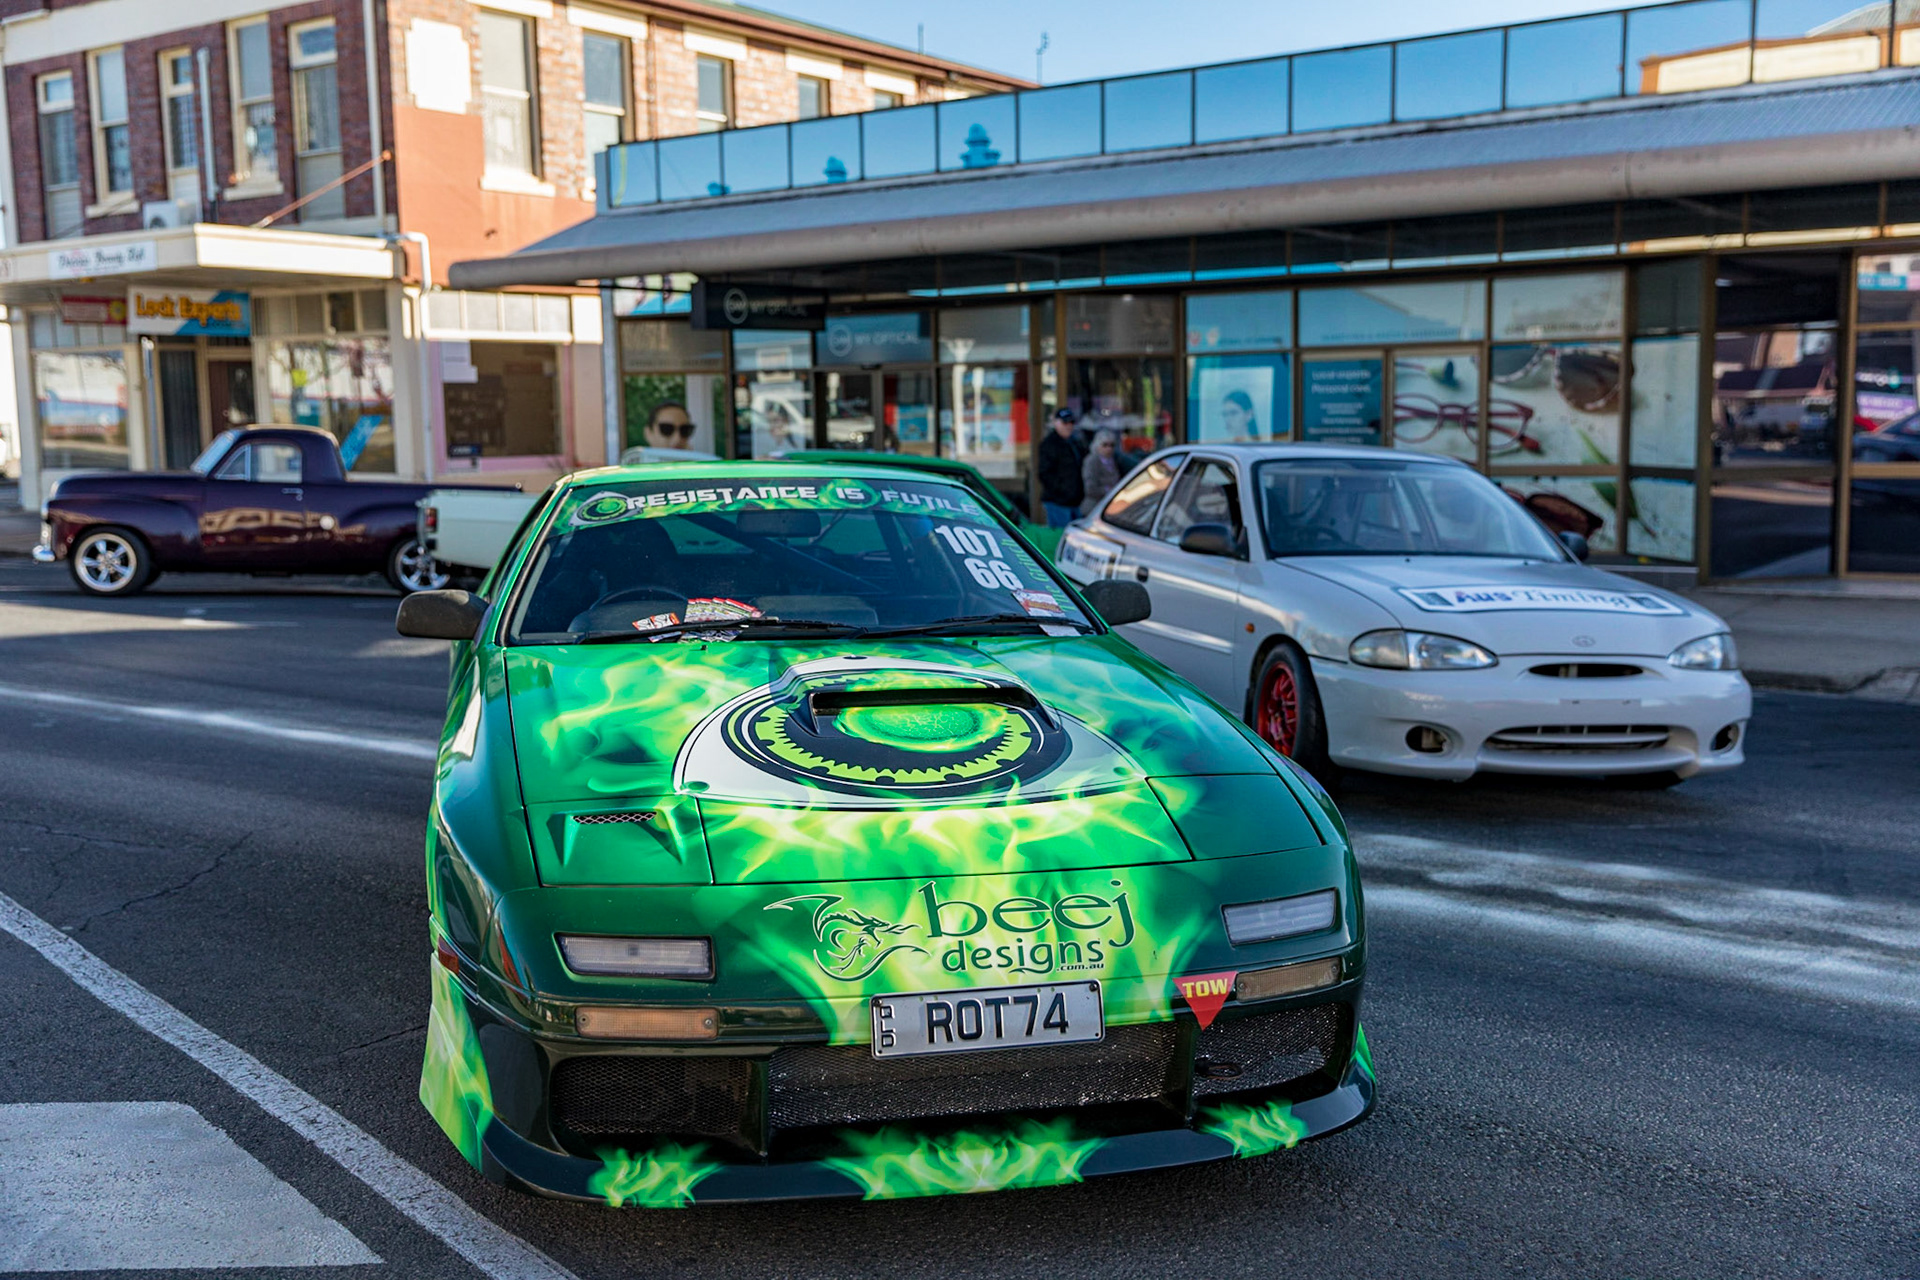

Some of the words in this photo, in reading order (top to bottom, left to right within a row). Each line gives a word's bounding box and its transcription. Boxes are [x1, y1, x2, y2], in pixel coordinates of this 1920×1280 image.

[626, 486, 819, 510] RESISTANCE
[835, 487, 865, 500] IS
[881, 490, 980, 516] FUTILE
[935, 525, 1003, 559] 107
[964, 557, 1024, 591] 66
[1513, 590, 1630, 609] Timing
[918, 880, 1135, 948] beej
[942, 938, 1104, 975] designs
[1056, 963, 1105, 972] .com.au
[1181, 978, 1228, 998] TOW
[880, 1004, 897, 1048] QLD
[926, 992, 1070, 1044] ROT74
